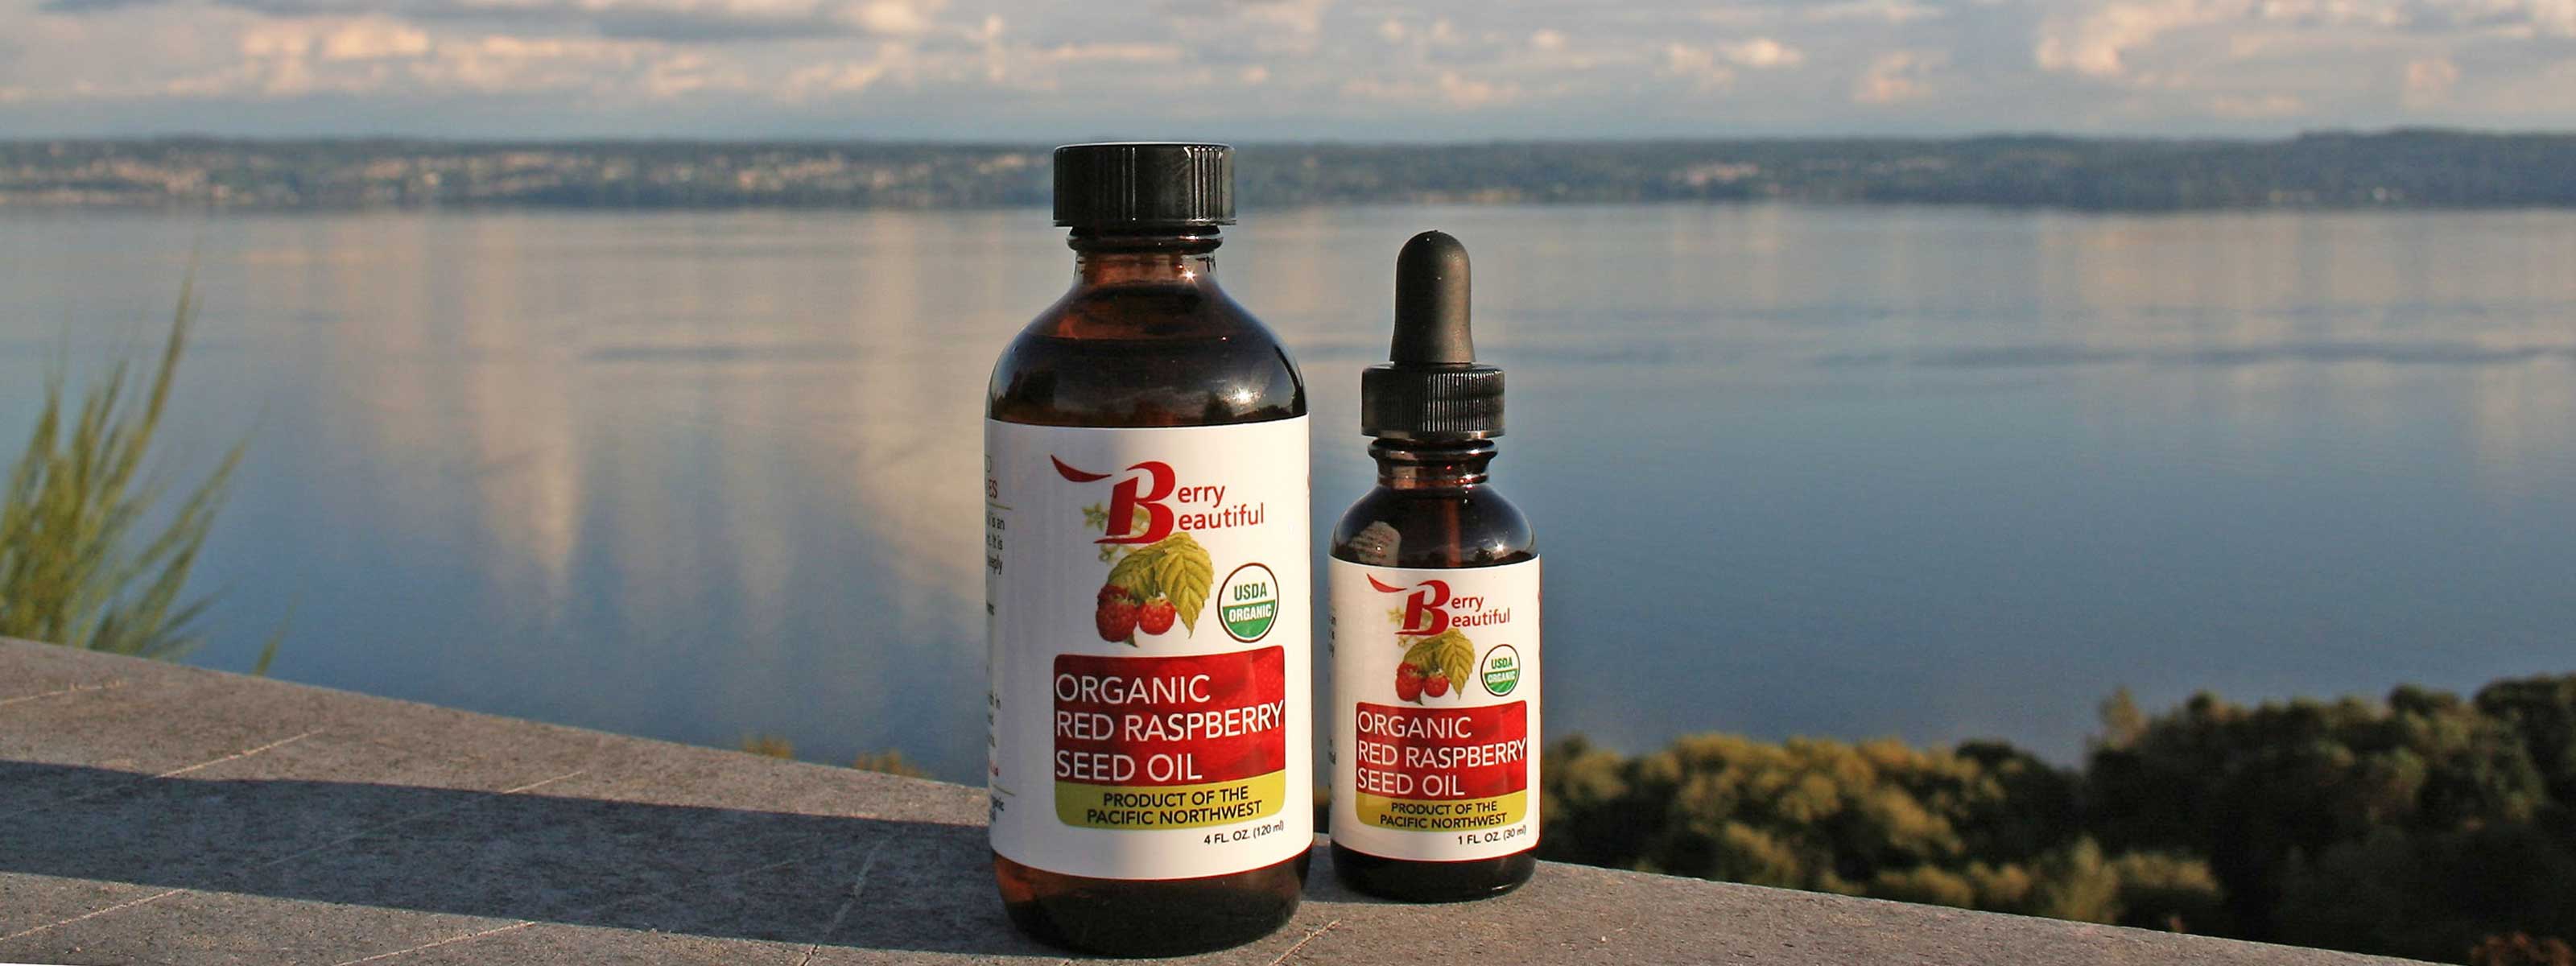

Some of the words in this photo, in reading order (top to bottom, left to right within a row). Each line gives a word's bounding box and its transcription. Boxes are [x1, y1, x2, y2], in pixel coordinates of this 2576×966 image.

[1234, 581, 1268, 601] USDA
[1228, 604, 1273, 623] ORGANIC
[1491, 658, 1513, 669] USDA
[1488, 671, 1516, 683] ORGANIC
[1055, 673, 1212, 704] ORGANIC
[1056, 710, 1114, 741] RED
[1125, 700, 1284, 742] RASPBERRY
[1357, 712, 1472, 738] ORGANIC
[1358, 741, 1398, 766] RED
[1406, 737, 1527, 769] RASPBERRY
[1055, 752, 1136, 782] SEED
[1147, 753, 1203, 782] OIL
[1357, 768, 1414, 795] SEED
[1422, 773, 1465, 796] OIL
[1103, 792, 1186, 807] PRODUCT
[1191, 791, 1215, 805] OF
[1222, 786, 1249, 802] THE
[1087, 809, 1154, 825] PACIFIC
[1159, 800, 1262, 825] NORTHWEST
[1391, 802, 1452, 815] PRODUCT
[1456, 803, 1473, 815] OF
[1476, 800, 1497, 812] THE
[1380, 814, 1427, 828] PACIFIC
[1430, 812, 1507, 828] NORTHWEST
[1203, 835, 1211, 845] 4
[1253, 825, 1271, 840] (120
[1458, 835, 1463, 844] 1
[1503, 828, 1516, 841] (30
